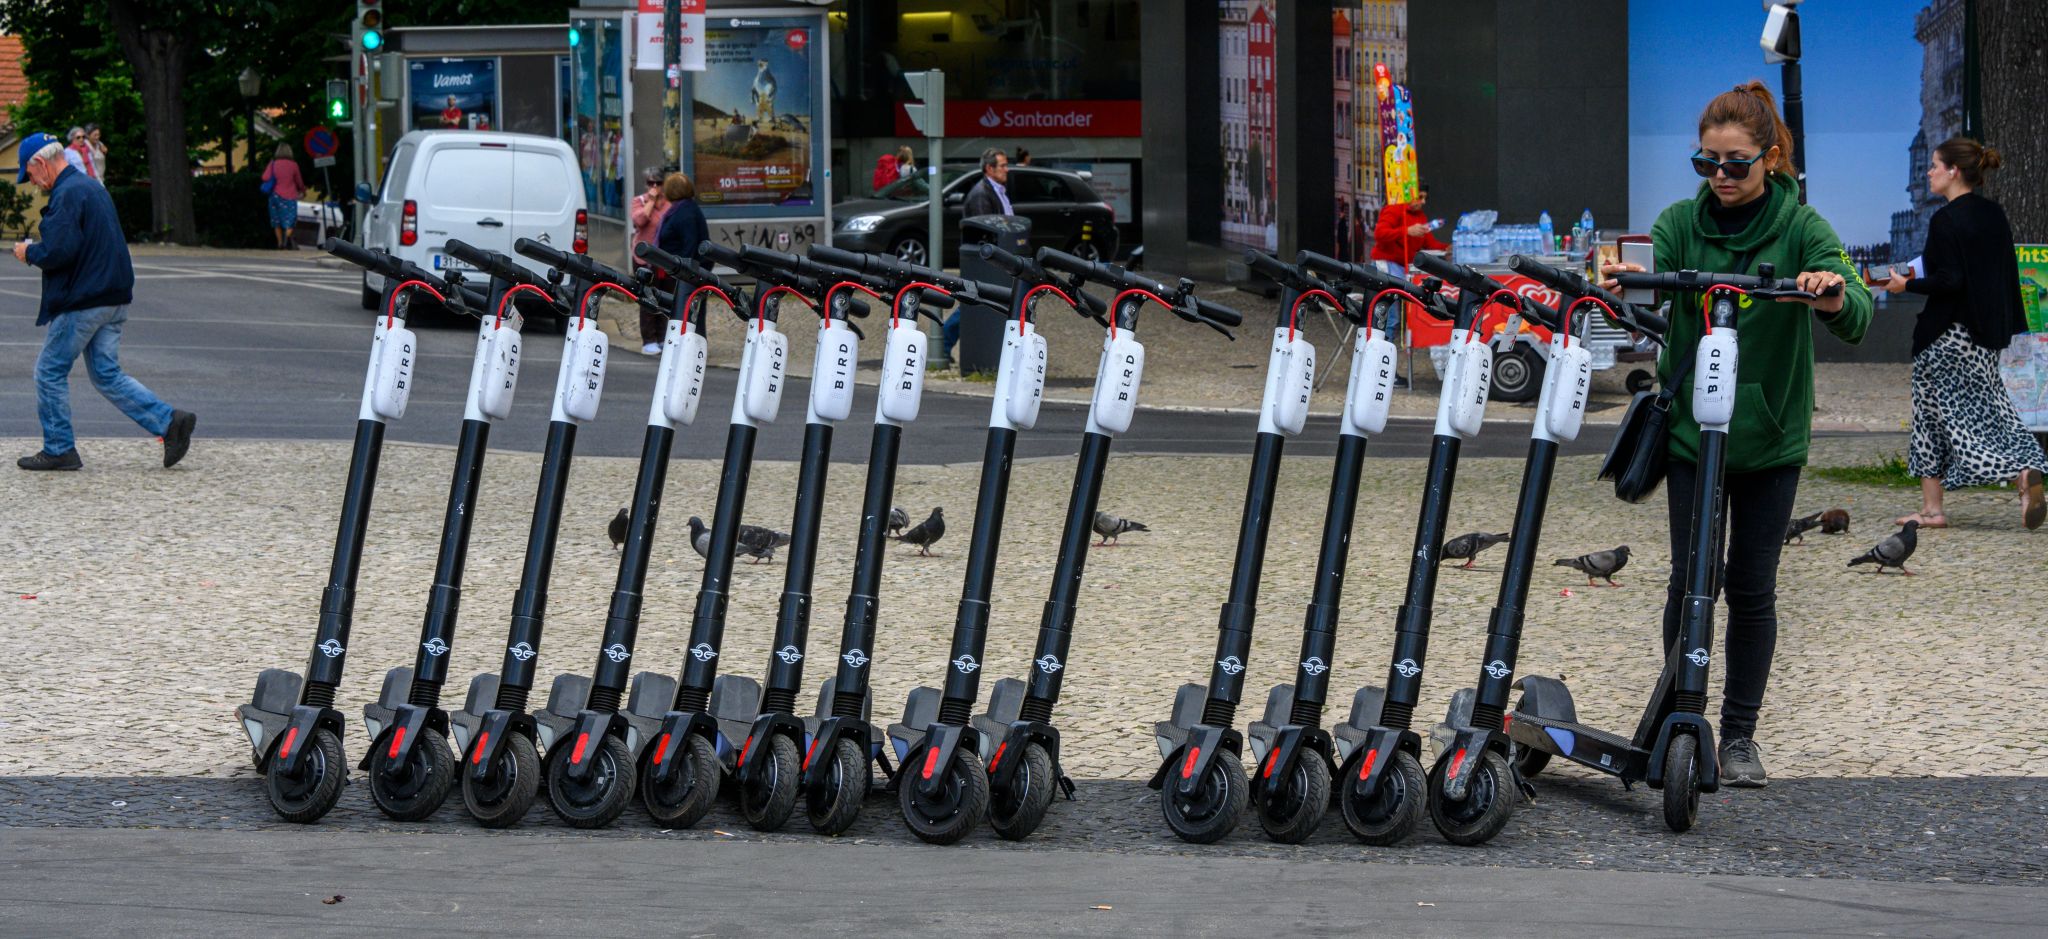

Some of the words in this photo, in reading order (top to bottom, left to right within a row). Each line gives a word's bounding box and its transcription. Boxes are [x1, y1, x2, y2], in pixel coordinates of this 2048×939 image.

[433, 73, 474, 89] Vamos
[1003, 111, 1093, 127] Santander
[2016, 246, 2048, 263] hts
[396, 343, 411, 389] BIRD
[588, 343, 602, 391] BIRD
[690, 350, 704, 397] BIRD
[768, 347, 783, 393] BIRD
[834, 343, 849, 390] BIRD
[902, 343, 917, 390] BIRD
[1033, 350, 1045, 398] BIRD
[1118, 354, 1135, 402] BIRD
[1300, 357, 1313, 404] BIRD
[1375, 354, 1390, 401] BIRD
[1475, 358, 1489, 405] BIRD
[1572, 363, 1589, 410] BIRD
[1707, 348, 1721, 394] BIRD
